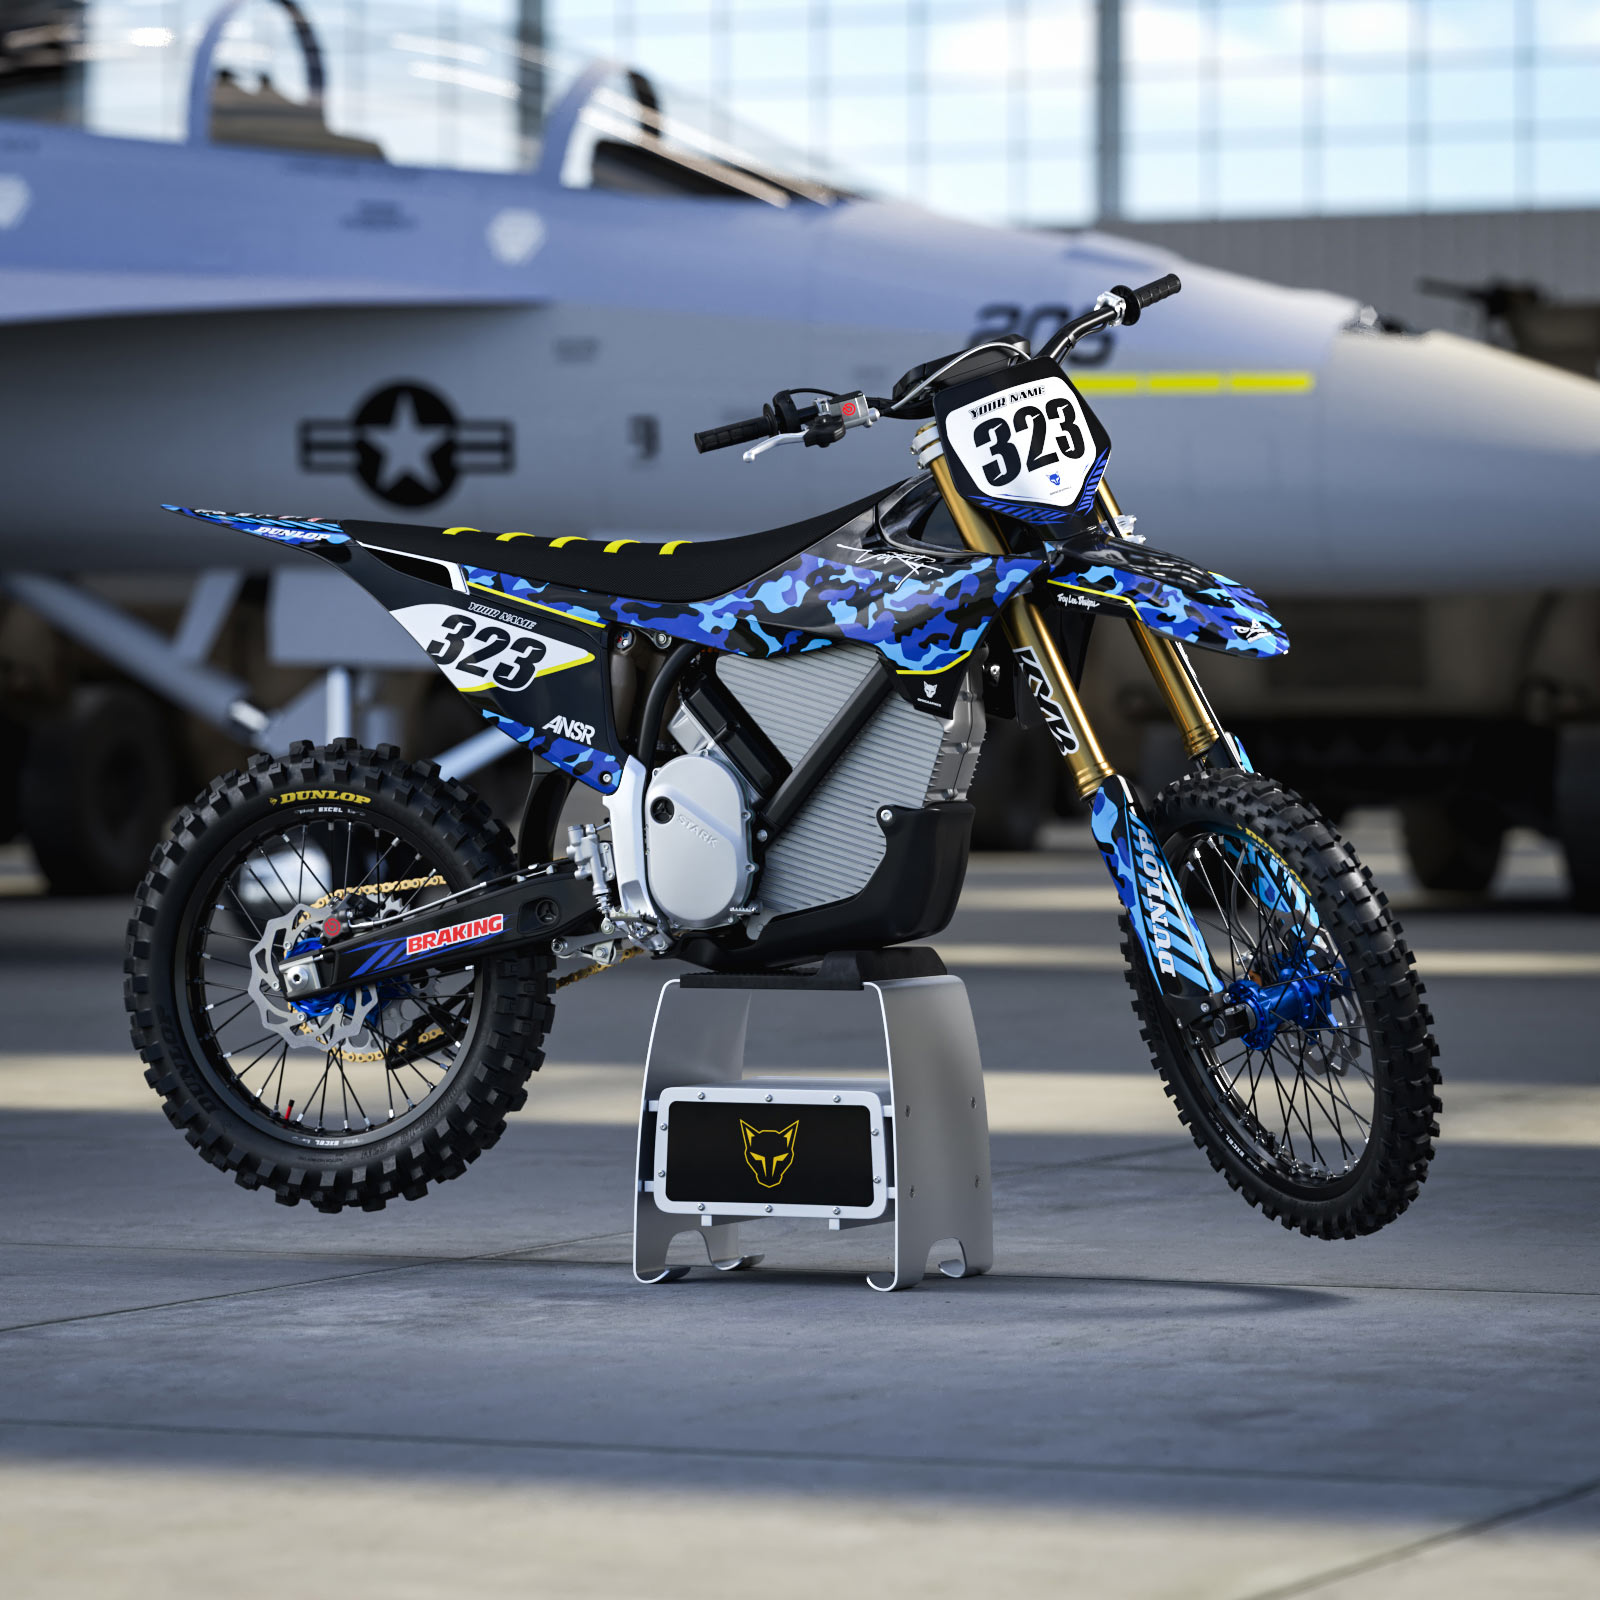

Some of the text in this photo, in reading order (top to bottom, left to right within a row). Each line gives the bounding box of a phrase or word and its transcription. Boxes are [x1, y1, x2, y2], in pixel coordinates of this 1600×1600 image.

[1009, 385, 1046, 404] NAME
[973, 397, 1086, 487] 323
[254, 525, 331, 541] DUNLOP
[499, 611, 537, 630] NAME
[426, 613, 548, 691] 323
[541, 714, 597, 746] ANSR
[280, 789, 372, 805] DUNLOP
[677, 813, 719, 849] STARK
[1138, 828, 1177, 978] DUNLOP
[406, 913, 504, 956] BRAKING
